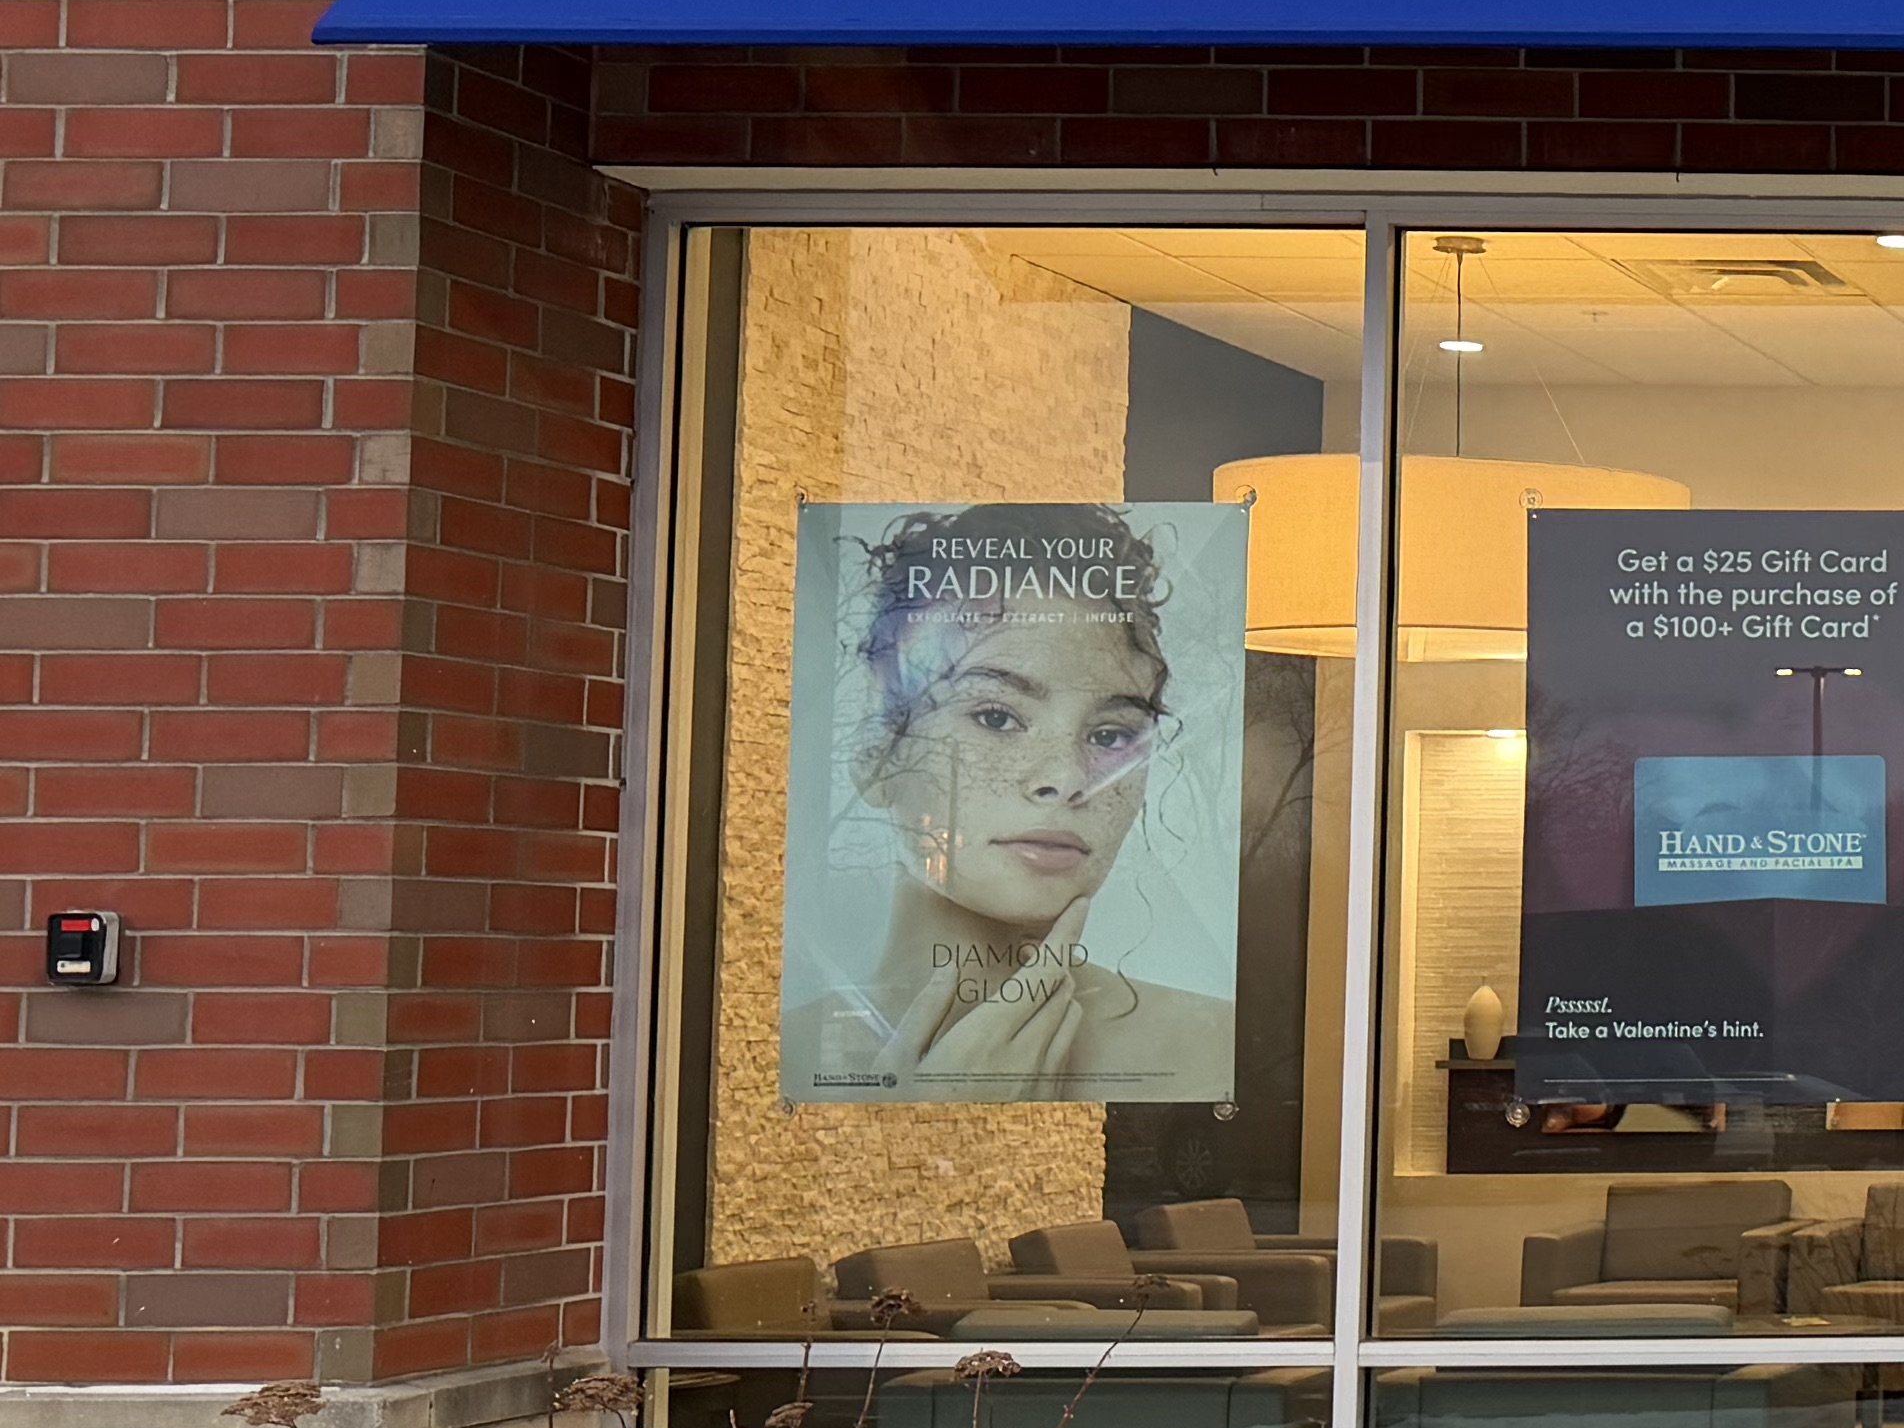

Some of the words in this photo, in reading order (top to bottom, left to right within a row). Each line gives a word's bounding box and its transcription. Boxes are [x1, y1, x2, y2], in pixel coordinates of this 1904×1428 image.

[931, 537, 1032, 560] REVEAL
[1041, 537, 1115, 560] YOUR
[1617, 549, 1668, 572] Get
[1676, 554, 1694, 572] a
[1703, 548, 1752, 574] $25
[1761, 549, 1812, 573] Gift
[1819, 549, 1888, 573] Card
[907, 565, 1137, 600] RADIANCE
[1609, 581, 1669, 605] with
[1677, 581, 1723, 605] the
[1731, 582, 1862, 612] purchase
[1869, 582, 1898, 606] of
[907, 612, 981, 623] EXFOLIATE
[1002, 612, 1064, 623] EXTRACT
[1086, 612, 1134, 623] INFUSE
[1626, 620, 1644, 638] a
[1653, 614, 1733, 639] $100+
[1742, 614, 1793, 638] Gift
[1658, 830, 1746, 855] HAND
[1750, 835, 1763, 850] &
[1667, 860, 1732, 869] MASSAGE
[1740, 859, 1768, 868] AND
[1774, 858, 1823, 867] FACIAL
[1830, 857, 1852, 867] SPA
[932, 943, 1089, 969] DIAMOND
[956, 978, 1060, 1004] GLOW
[1545, 1021, 1590, 1039] Take
[1595, 1025, 1608, 1039] a
[1613, 1020, 1718, 1039] Valentine's
[1722, 1020, 1764, 1039] hint.
